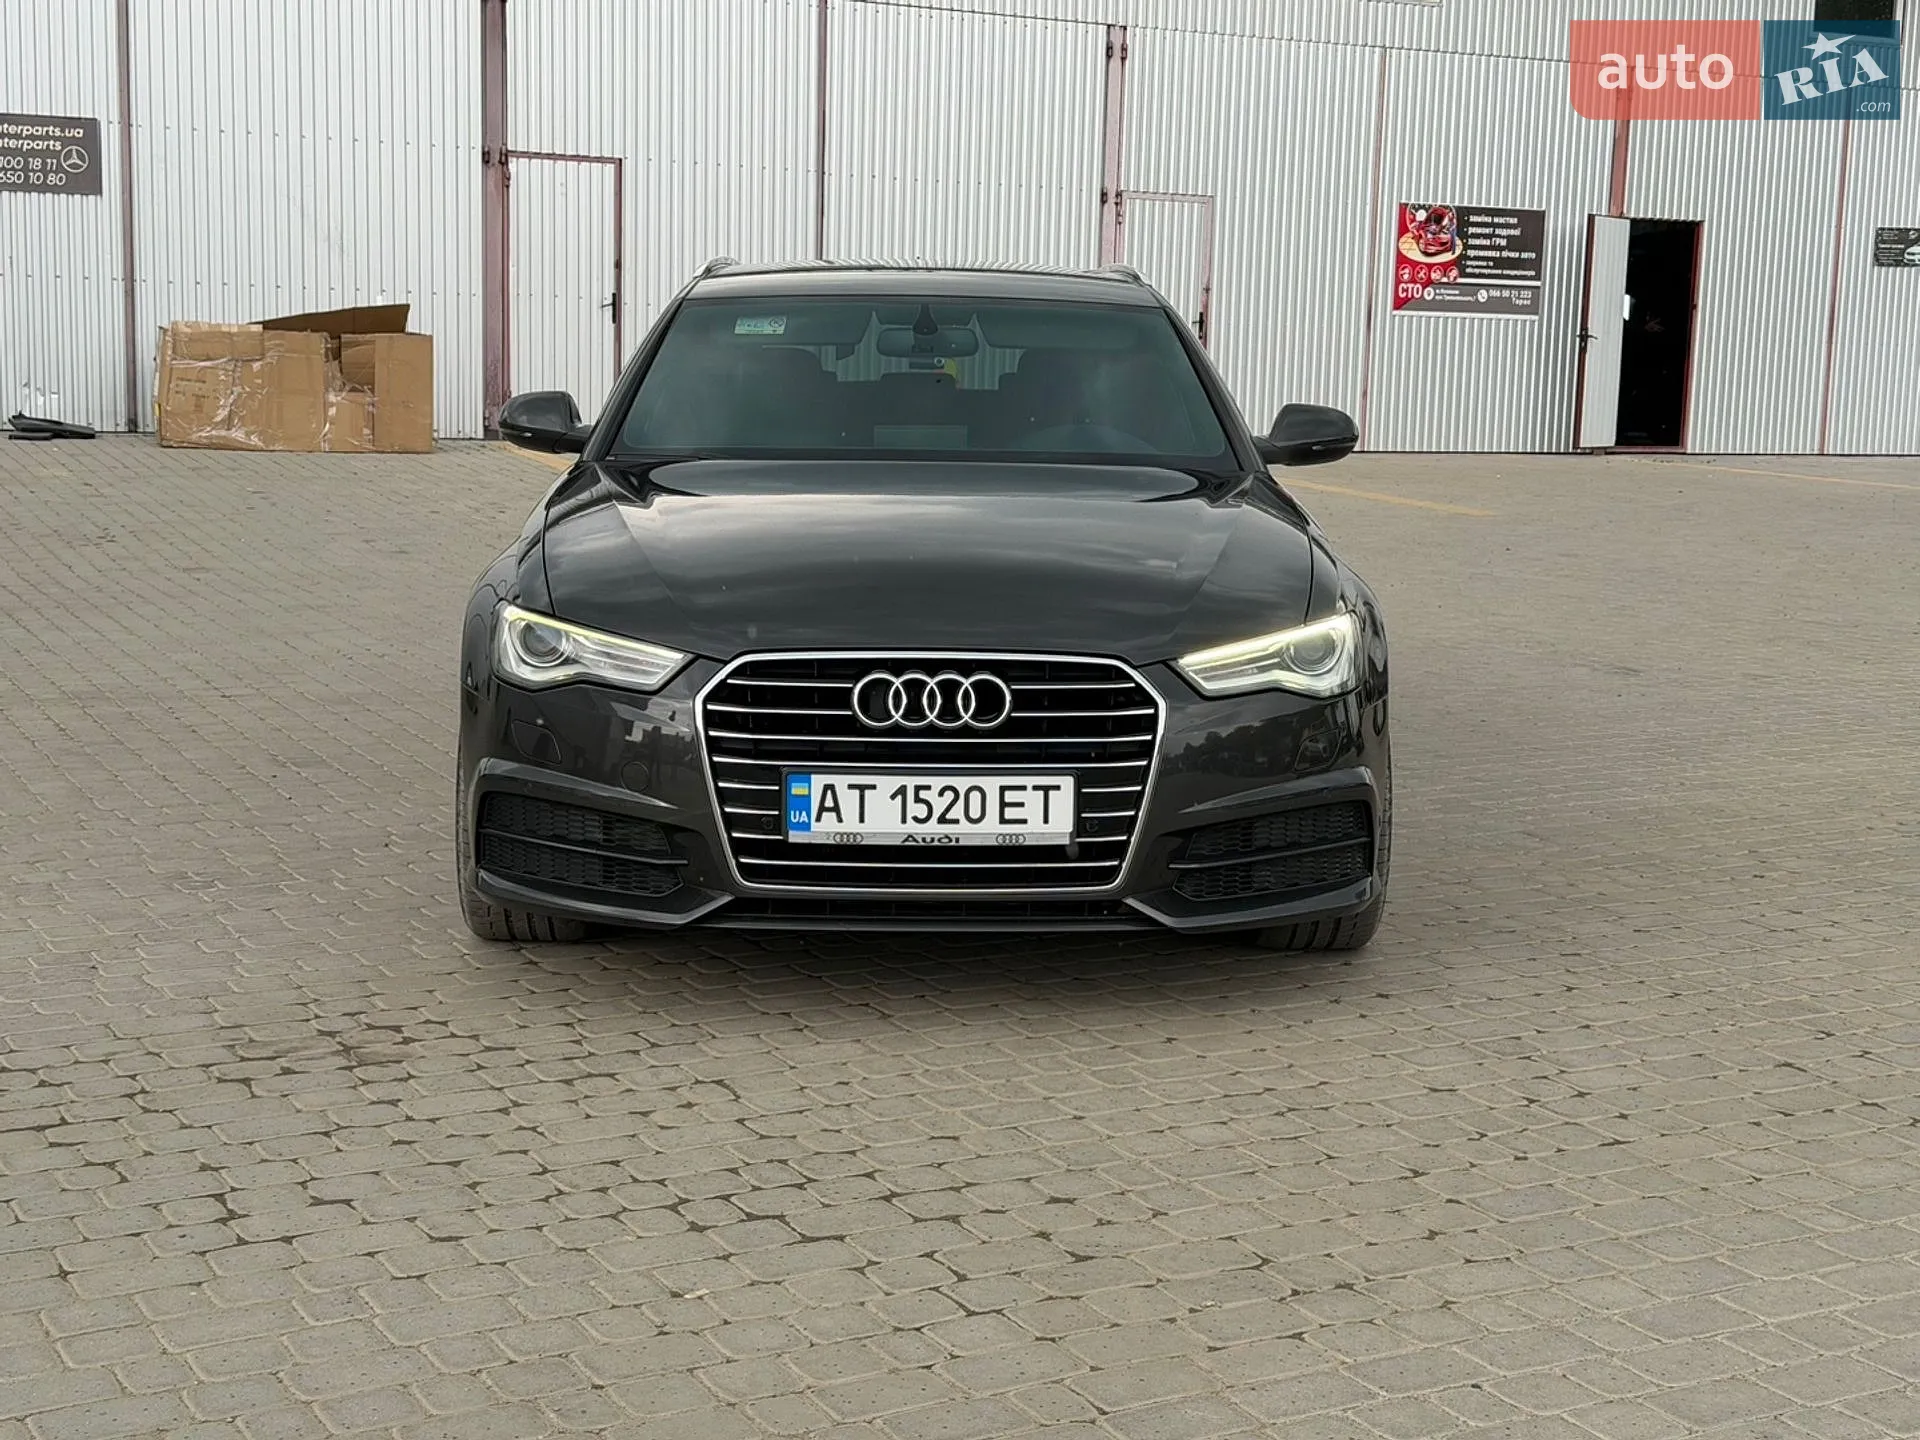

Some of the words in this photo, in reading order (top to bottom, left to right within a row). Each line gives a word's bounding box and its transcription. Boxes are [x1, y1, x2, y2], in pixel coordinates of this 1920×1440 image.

[0, 123, 84, 137] terparts.ua
[28, 157, 42, 170] 18
[46, 158, 57, 171] 11
[28, 172, 44, 185] 10
[46, 173, 66, 186] 80
[1398, 283, 1422, 298] СТО
[815, 784, 877, 824] AT
[889, 785, 987, 825] 1520
[999, 785, 1061, 825] ET
[790, 811, 809, 824] UA
[901, 835, 960, 845] Audi
